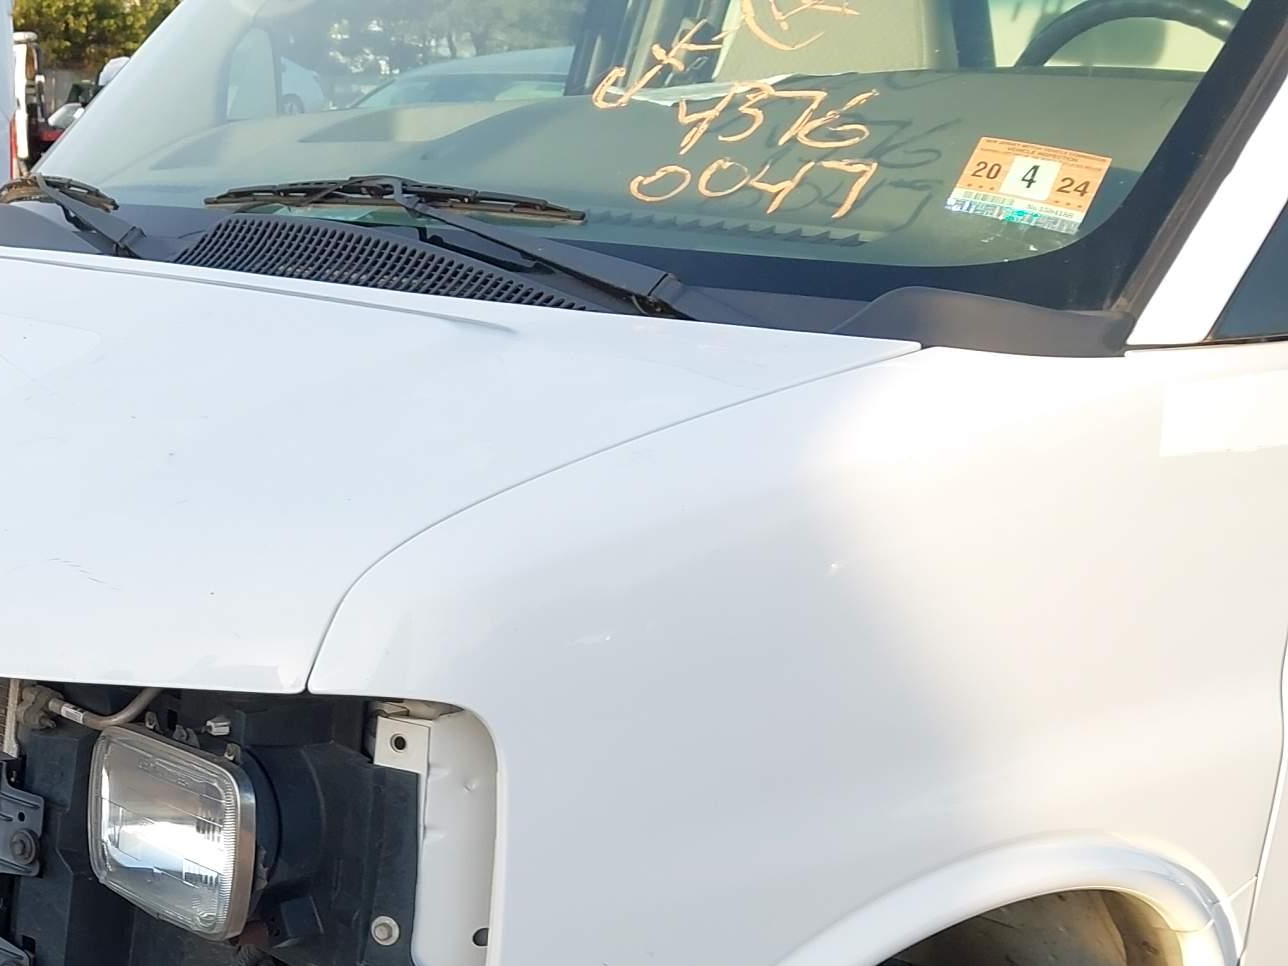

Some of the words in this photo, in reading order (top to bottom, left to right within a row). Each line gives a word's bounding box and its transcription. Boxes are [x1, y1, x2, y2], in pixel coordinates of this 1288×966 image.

[677, 81, 879, 155] 4376
[630, 157, 878, 220] 0047
[970, 161, 1003, 180] 20
[1021, 164, 1040, 188] 4
[1056, 177, 1091, 197] 24
